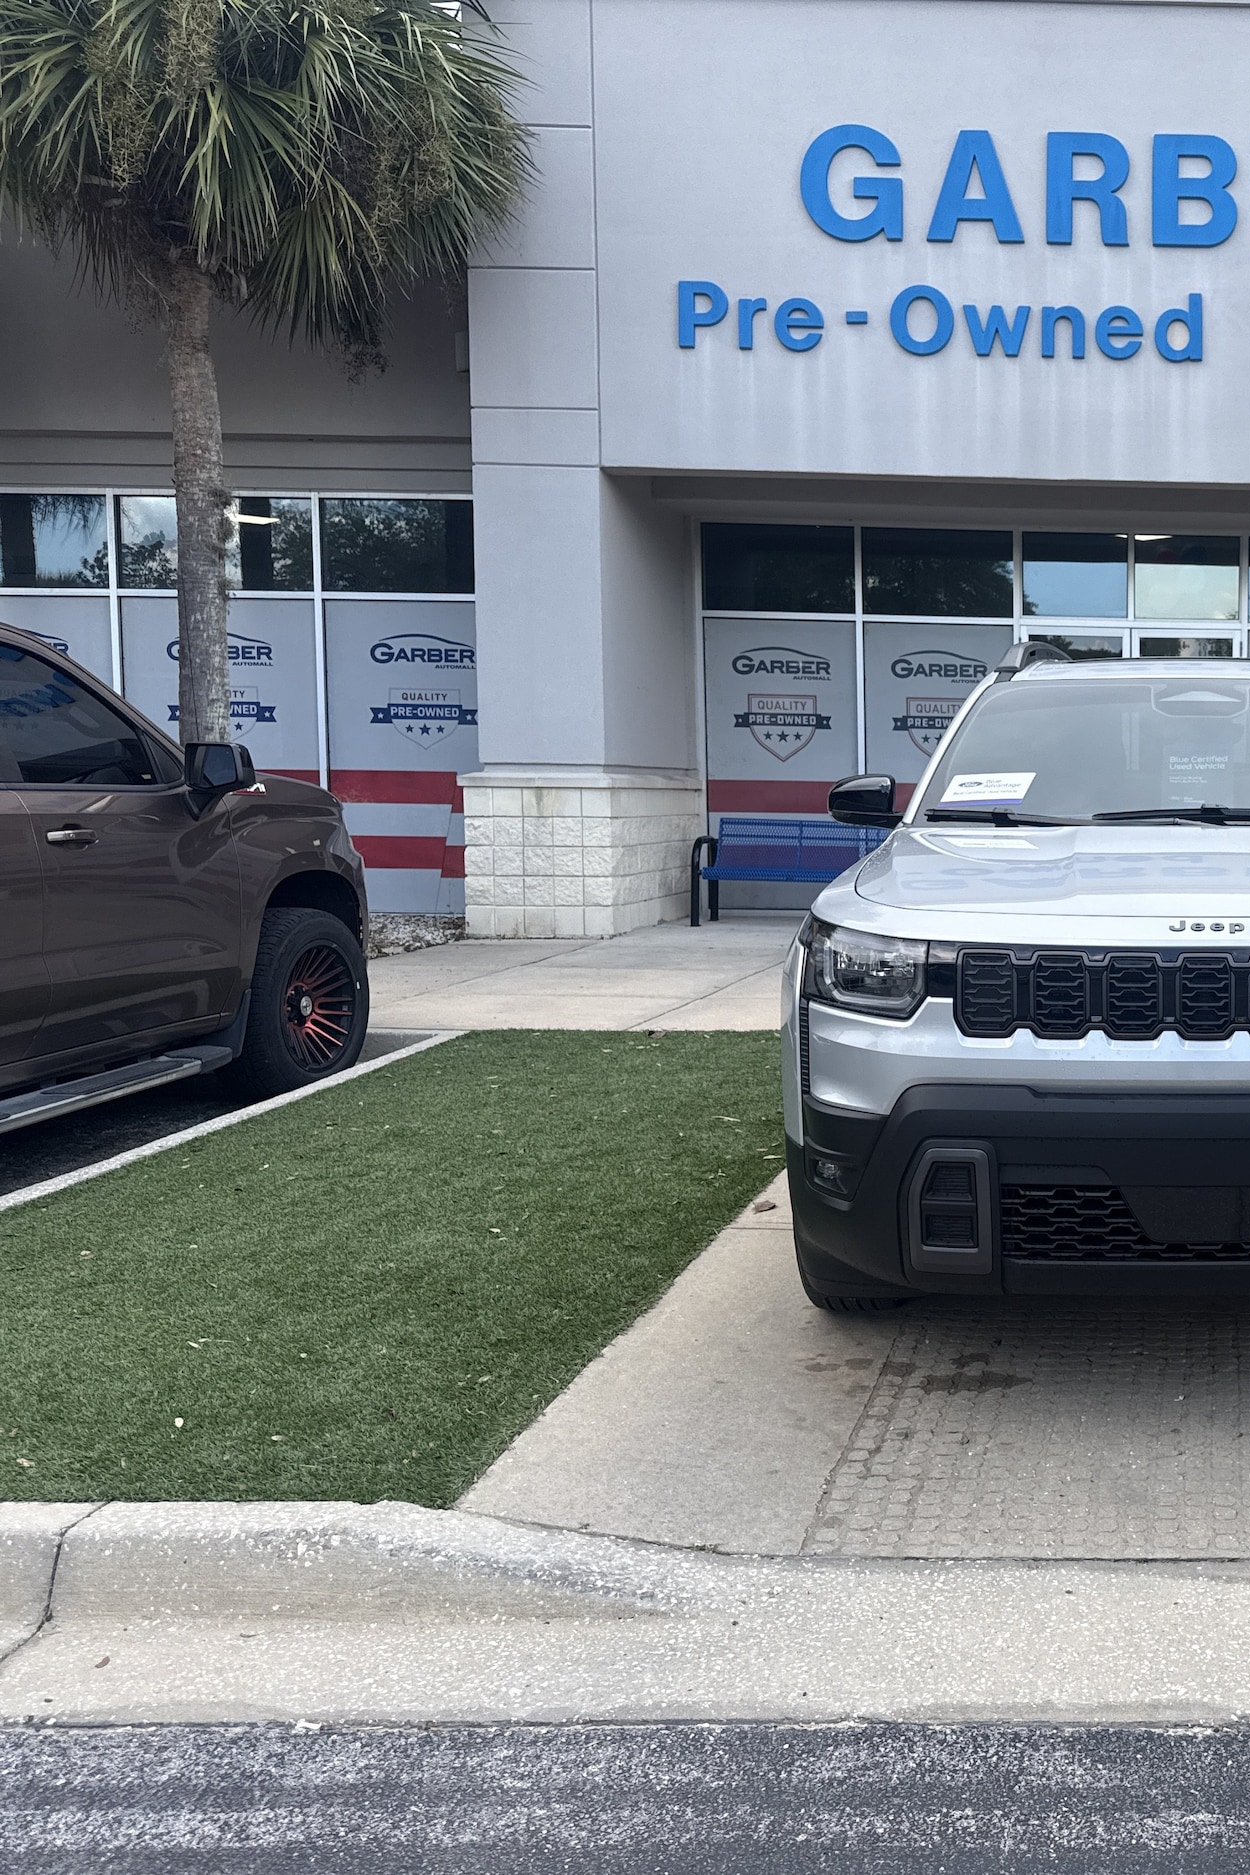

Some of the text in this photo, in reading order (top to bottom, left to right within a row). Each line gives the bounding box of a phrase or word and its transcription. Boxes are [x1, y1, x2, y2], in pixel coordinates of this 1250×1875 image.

[370, 642, 476, 664] GARBER
[732, 655, 831, 675] GARBER
[891, 658, 988, 679] GARBER
[401, 692, 448, 702] QUALITY
[757, 700, 807, 711] QUALITY
[390, 706, 460, 718] PRE-OWNED
[748, 714, 817, 725] PRE-OWNED
[907, 718, 953, 728] PRE-OW
[1191, 755, 1229, 763] Certified
[1169, 920, 1245, 934] Jeep
